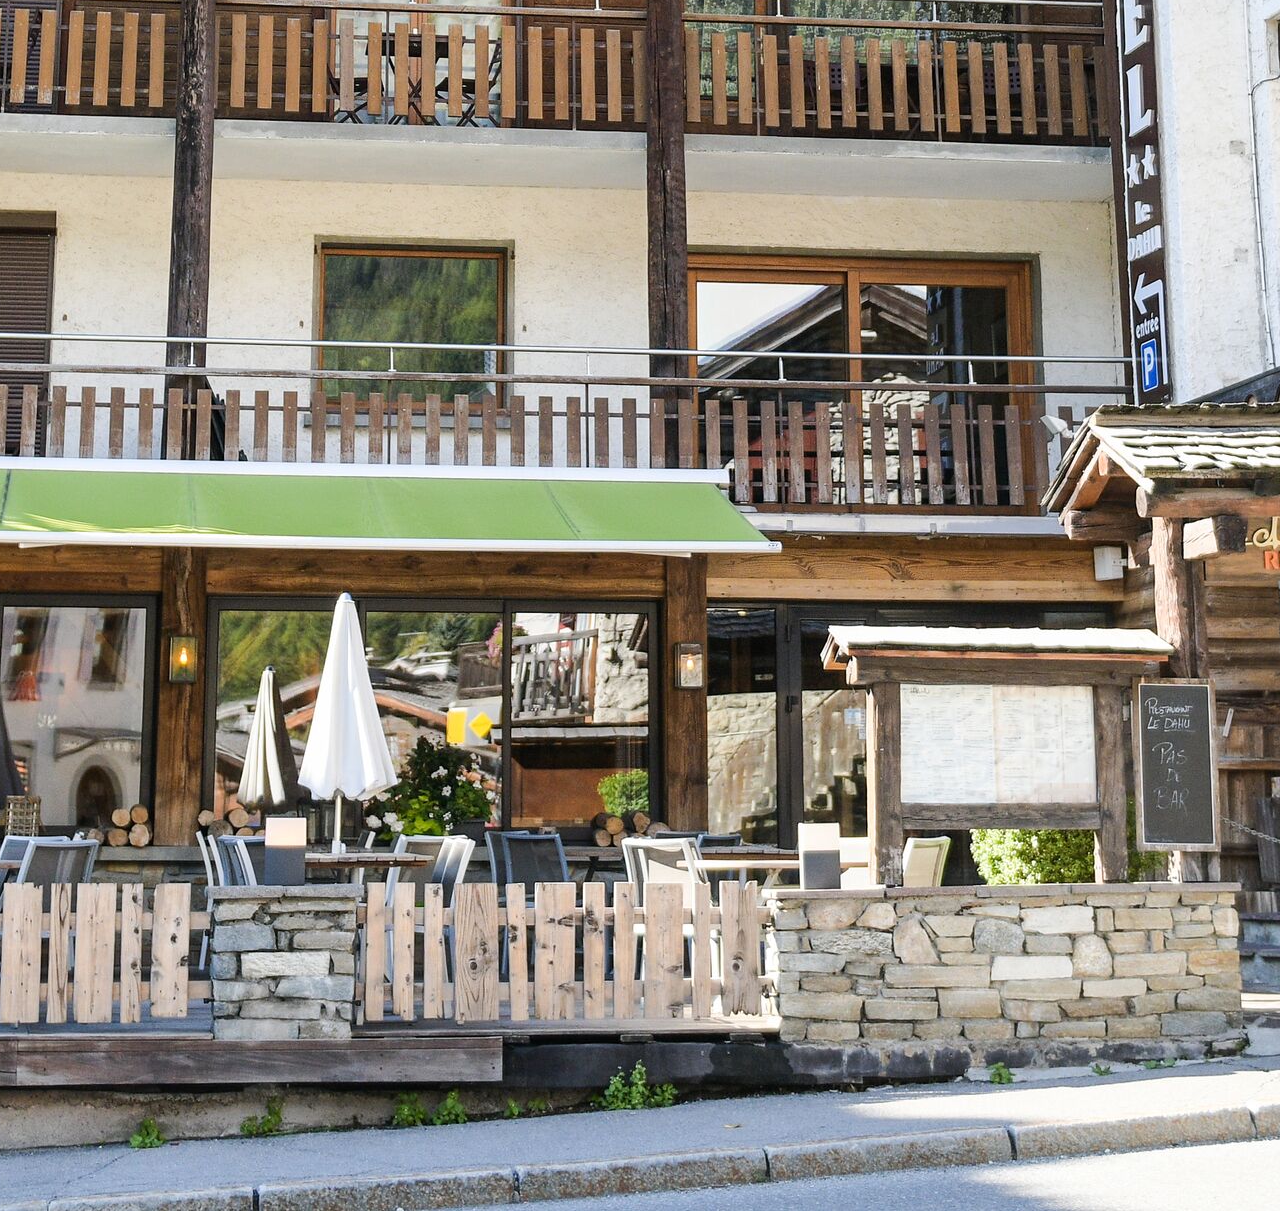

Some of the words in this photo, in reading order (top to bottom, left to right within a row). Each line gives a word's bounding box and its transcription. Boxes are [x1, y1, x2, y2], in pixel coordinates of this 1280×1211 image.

[1134, 200, 1154, 225] le
[1128, 224, 1162, 262] DAHU
[1135, 313, 1160, 339] entrée
[1143, 346, 1154, 386] P
[1163, 718, 1191, 730] DAHU
[1151, 741, 1188, 766] PAS
[1153, 788, 1190, 818] BAR
